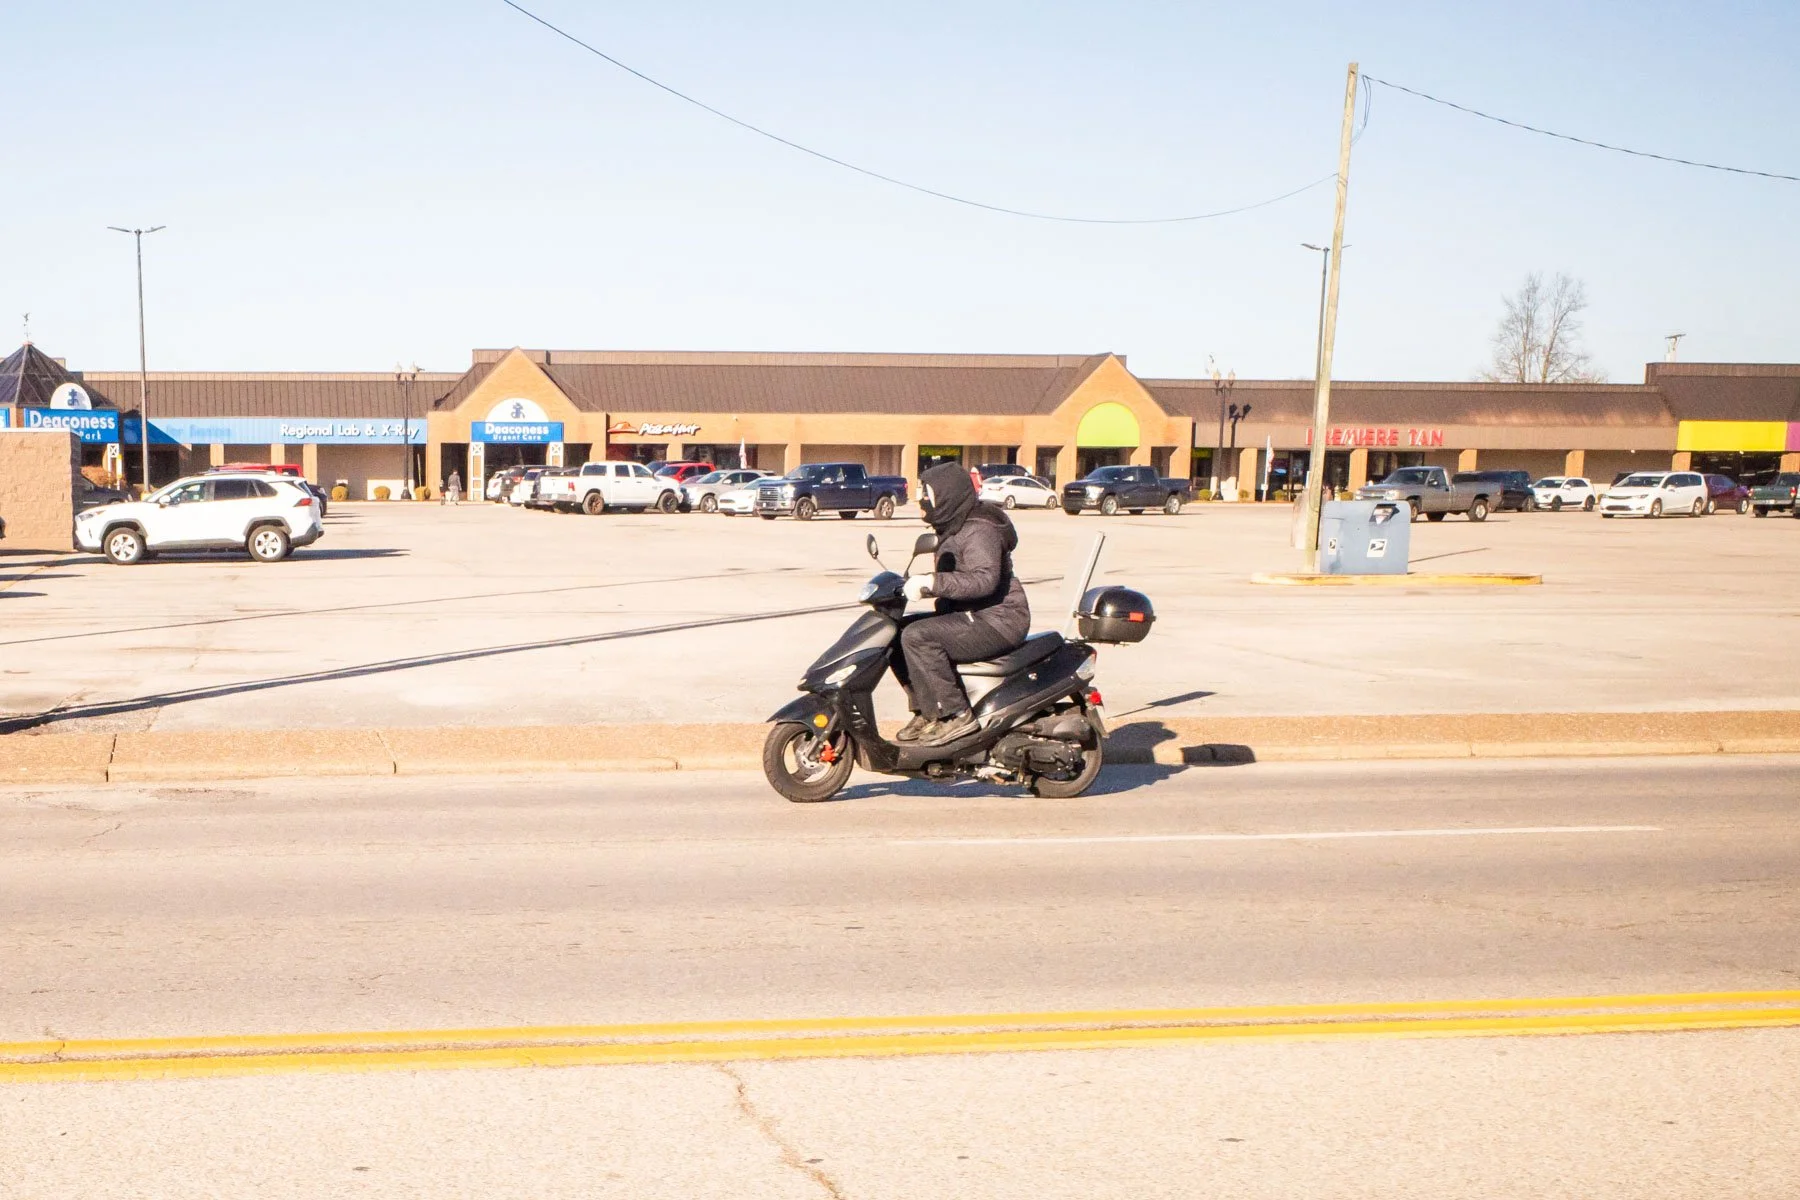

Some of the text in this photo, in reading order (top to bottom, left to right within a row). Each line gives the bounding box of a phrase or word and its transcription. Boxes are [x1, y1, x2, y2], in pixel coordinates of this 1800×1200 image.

[30, 410, 116, 430] Deaconess
[280, 424, 333, 439] Regional
[338, 424, 360, 437] Lab
[364, 424, 376, 437] &
[485, 423, 549, 435] Deaconess
[639, 423, 674, 436] Pizza
[1408, 428, 1444, 446] TAN
